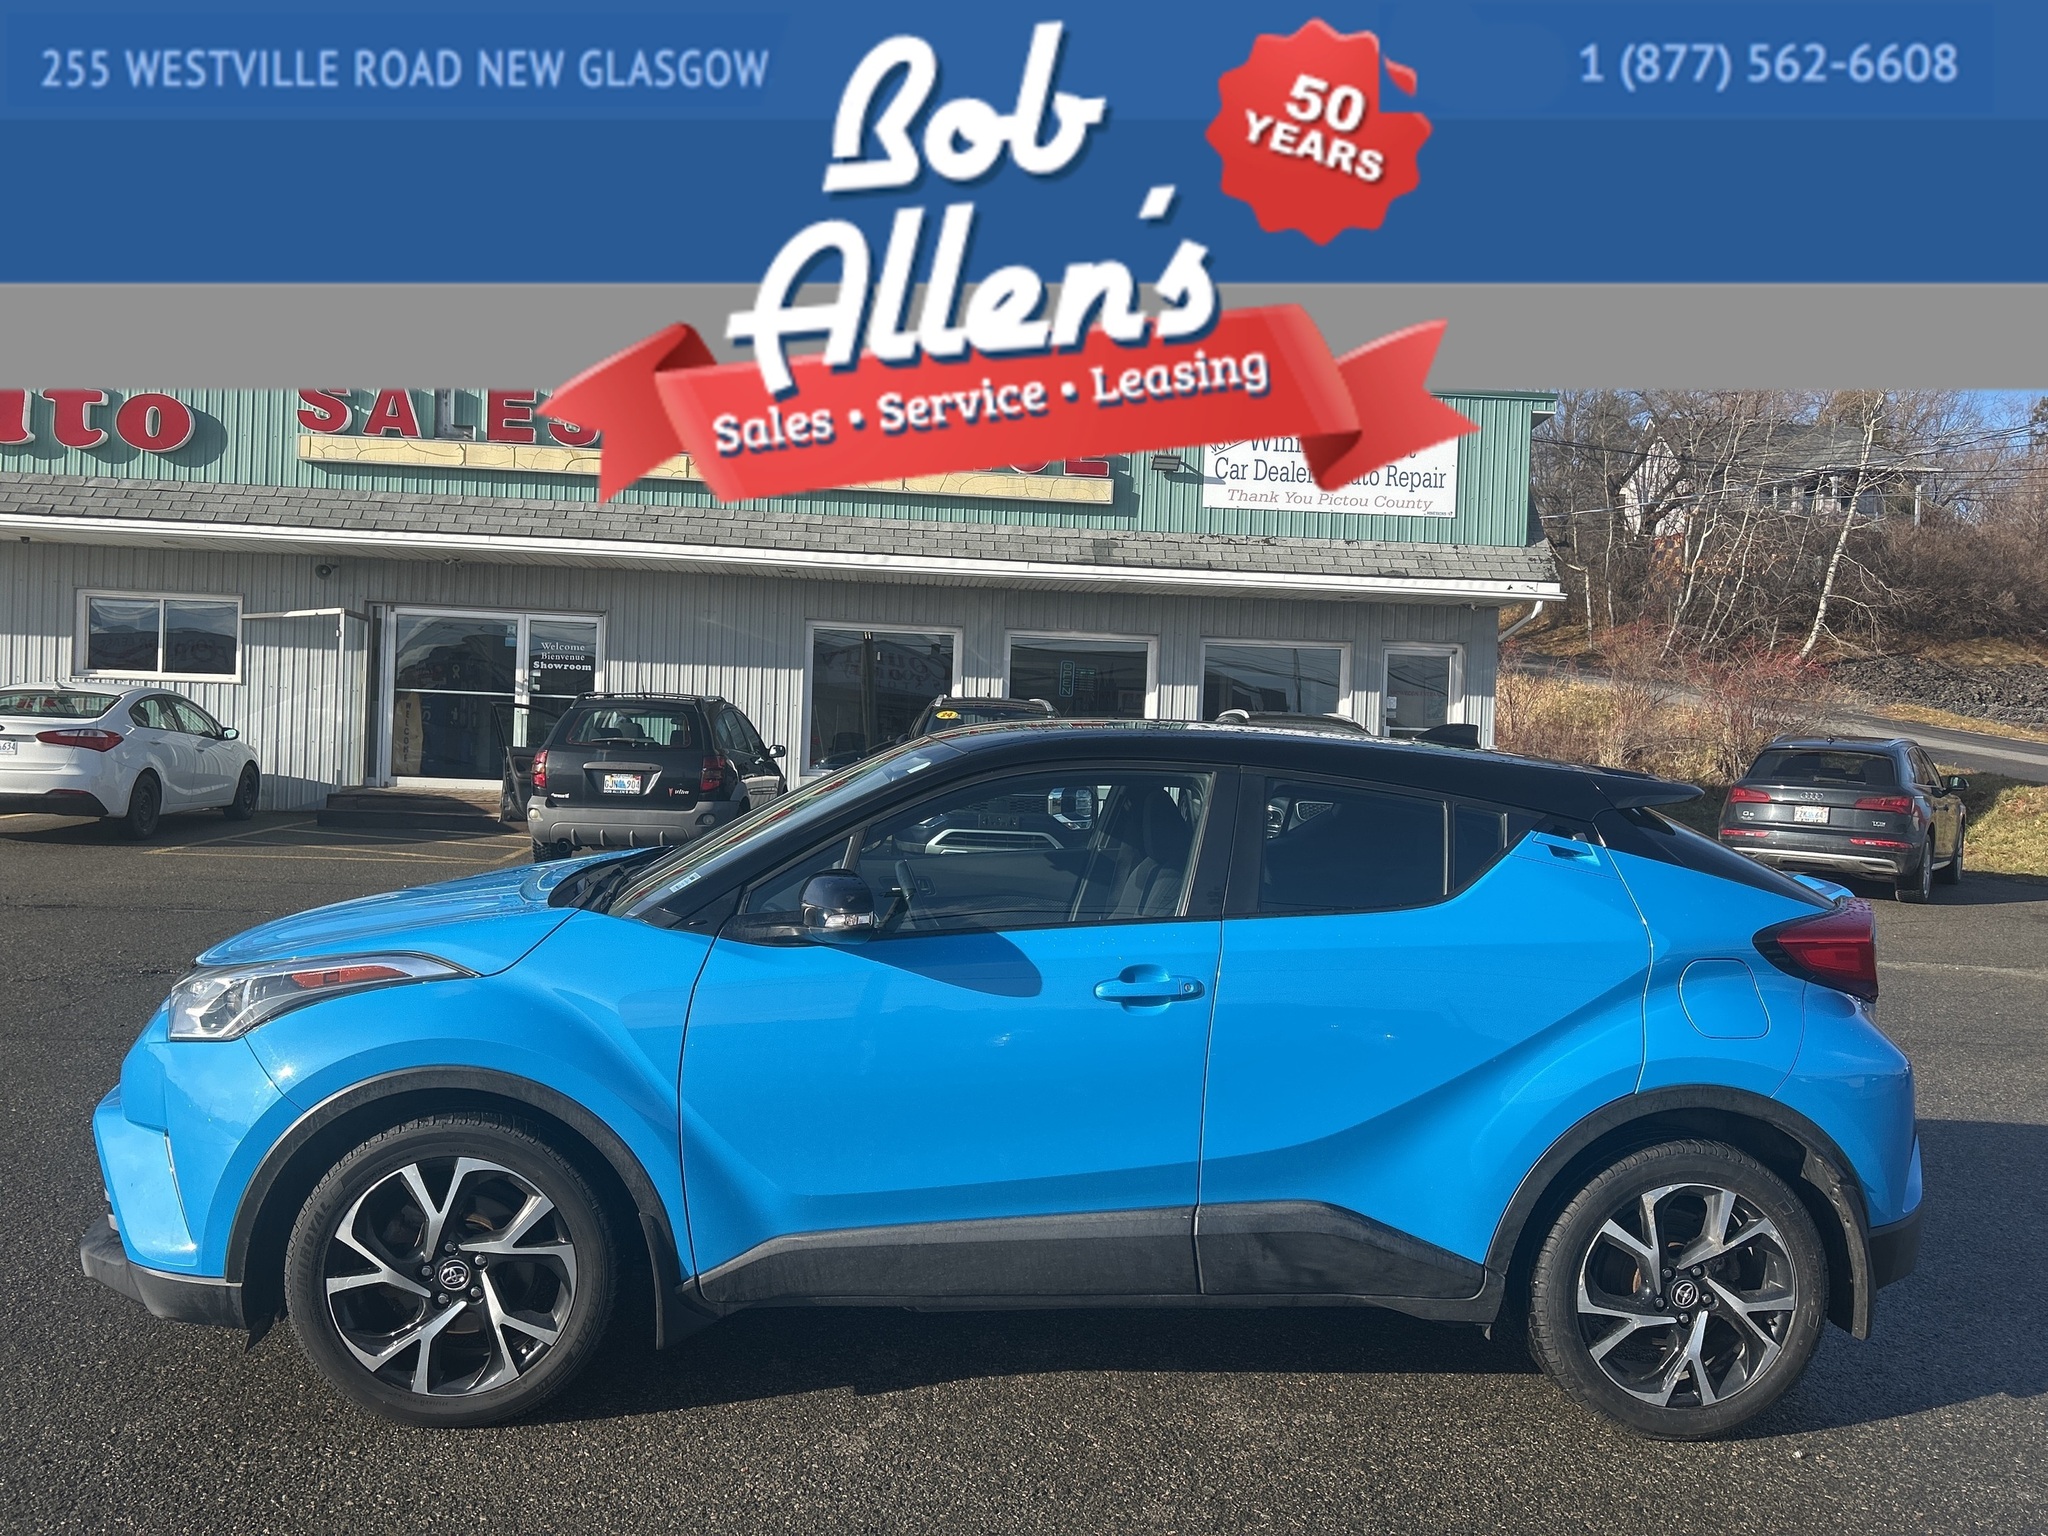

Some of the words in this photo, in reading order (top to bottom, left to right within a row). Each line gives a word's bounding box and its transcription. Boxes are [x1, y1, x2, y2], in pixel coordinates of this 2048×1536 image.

[1215, 456, 1248, 480] Car
[1385, 465, 1446, 493] Repair
[1228, 489, 1280, 503] Thank
[1285, 491, 1313, 505] You
[1317, 493, 1369, 507] Pictou
[1374, 495, 1433, 512] County
[541, 642, 585, 651] Welcome
[541, 652, 585, 660] Bienvenue
[533, 661, 592, 671] Showroom
[403, 702, 412, 763] WELCOME
[296, 1202, 331, 1301] UNIROYAL
